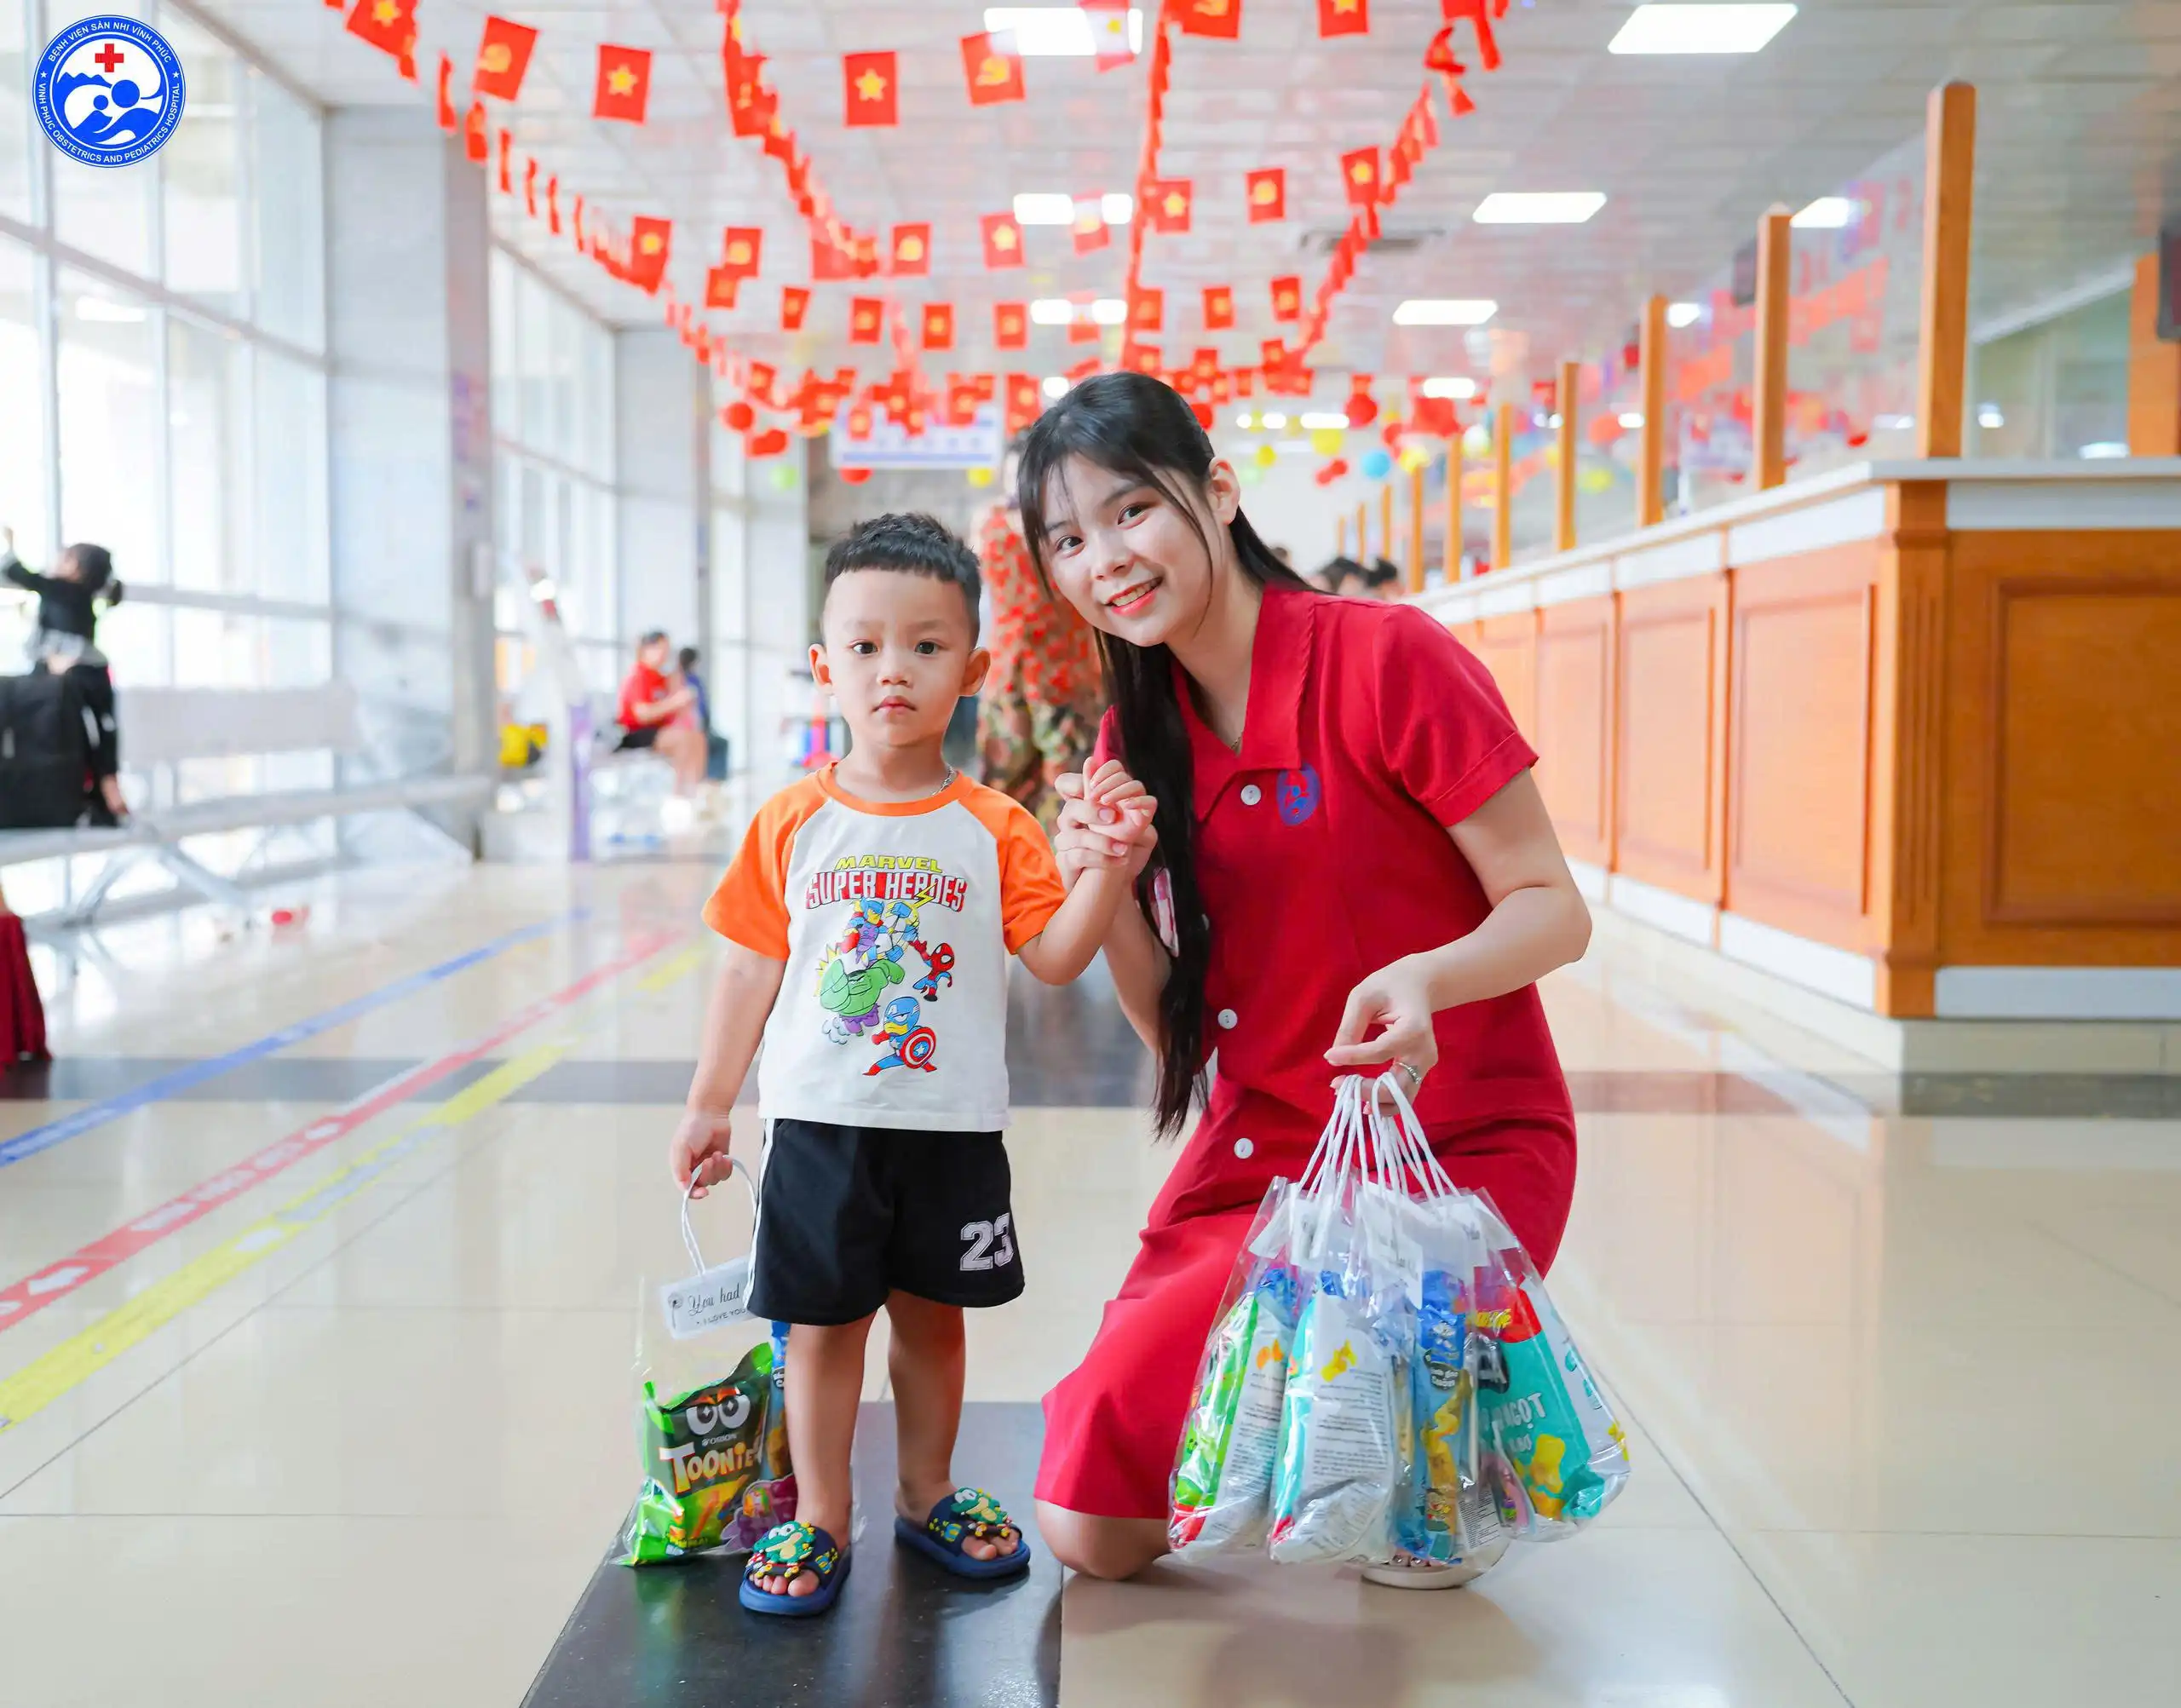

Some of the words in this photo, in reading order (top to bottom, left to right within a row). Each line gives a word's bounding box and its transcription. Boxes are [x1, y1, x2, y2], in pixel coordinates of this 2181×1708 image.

[834, 854, 943, 873] MARVEL
[804, 870, 878, 910] SUPER
[884, 871, 969, 913] HEROES
[959, 1212, 1014, 1271] 23
[688, 1295, 714, 1316] You
[719, 1282, 739, 1303] had
[707, 1313, 728, 1324] LOVE
[730, 1308, 746, 1316] YOU
